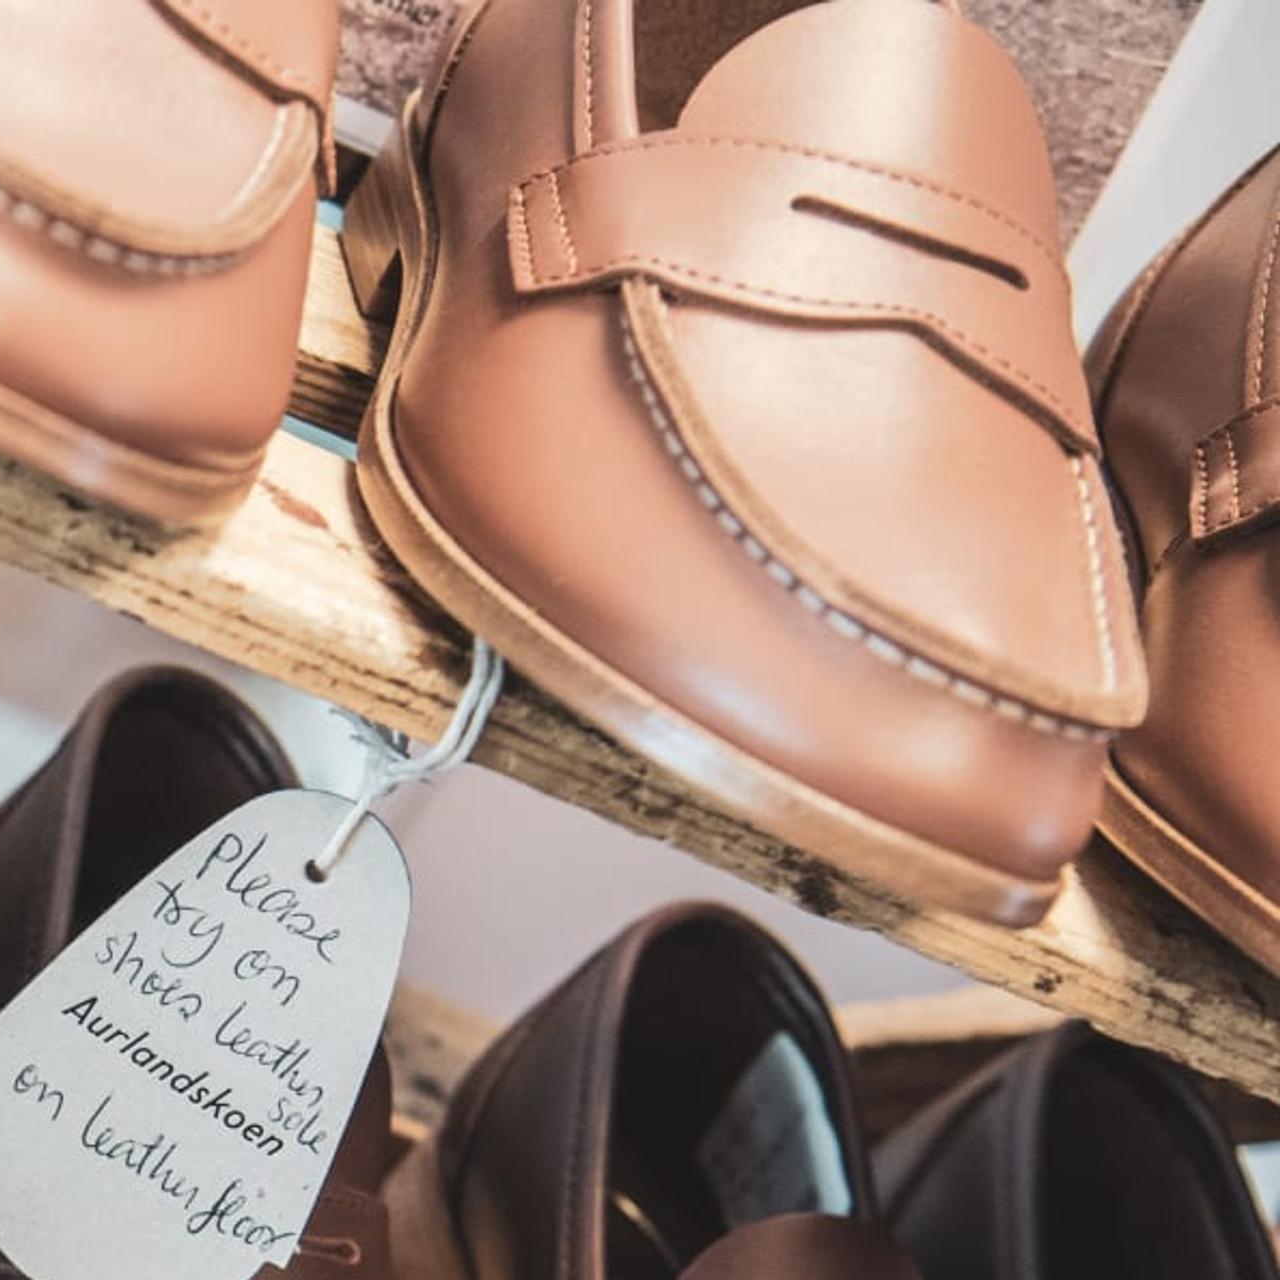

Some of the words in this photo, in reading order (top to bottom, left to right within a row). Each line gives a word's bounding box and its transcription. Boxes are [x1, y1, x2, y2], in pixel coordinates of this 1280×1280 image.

[153, 880, 224, 968] try
[233, 948, 300, 1006] on
[196, 833, 340, 964] Please
[94, 931, 202, 1021] shoes
[12, 1063, 65, 1121] on
[61, 995, 285, 1156] Aurlandskoen
